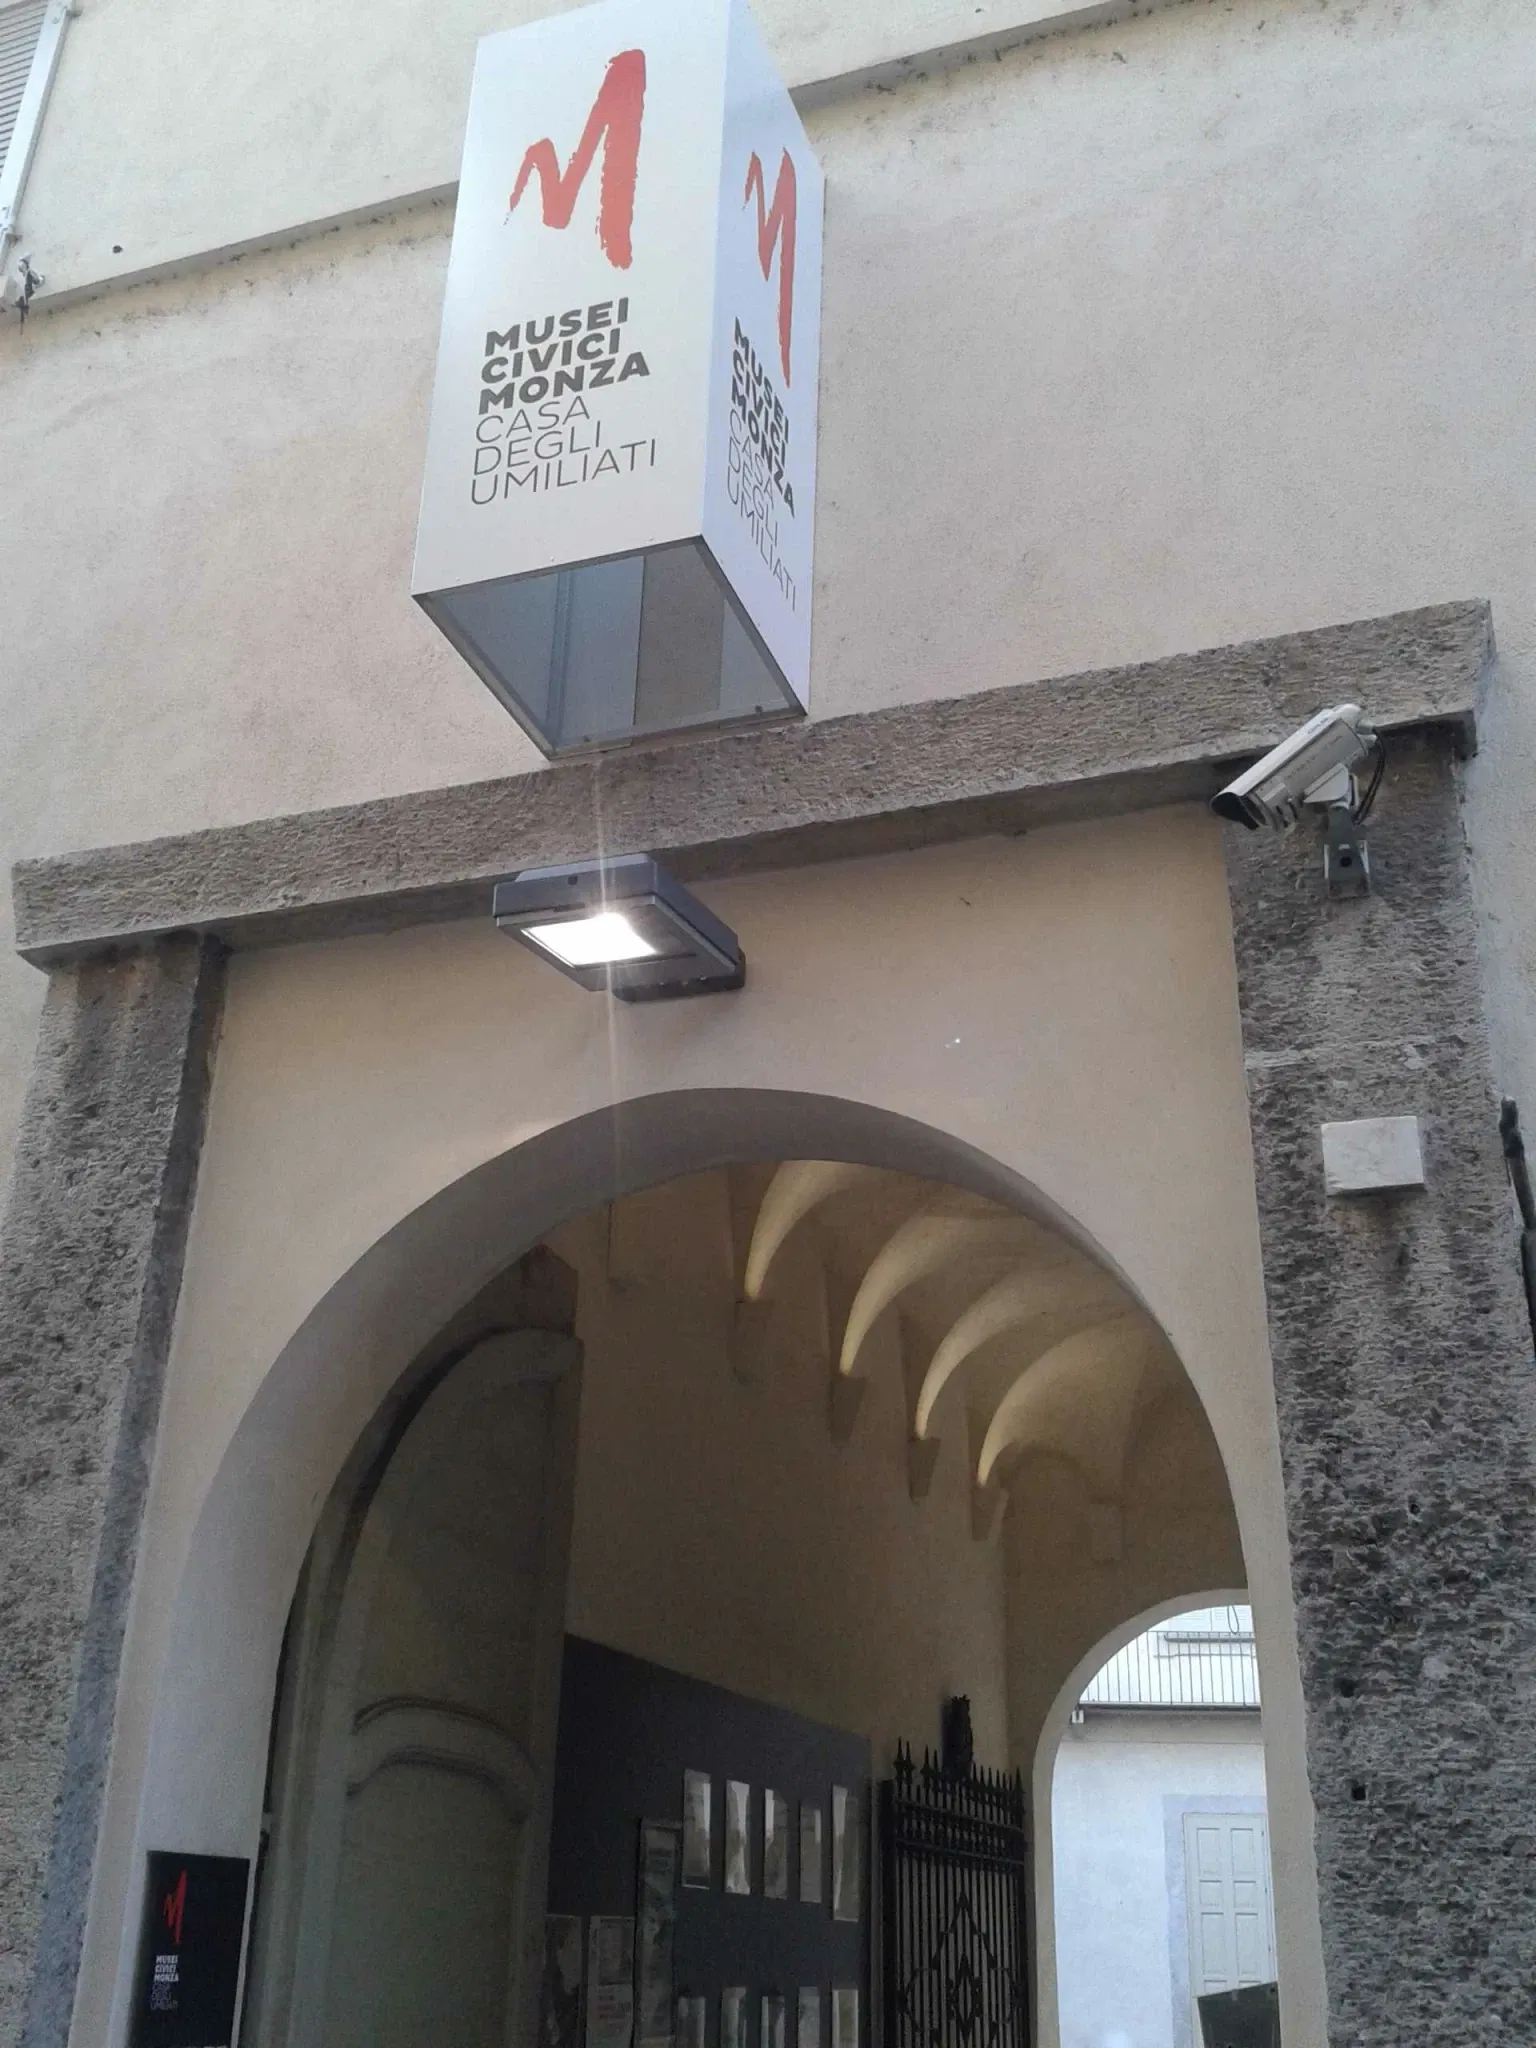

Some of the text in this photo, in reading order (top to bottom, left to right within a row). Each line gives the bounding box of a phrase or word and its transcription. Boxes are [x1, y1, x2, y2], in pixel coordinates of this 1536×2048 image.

[481, 327, 621, 384] CIVICI
[484, 296, 629, 357] MUSEI
[475, 395, 590, 444] CASA
[478, 351, 650, 416] MONZA
[732, 348, 787, 466] CIVICI
[735, 315, 789, 443] MUSEI
[471, 438, 656, 505] UMILIATI
[473, 420, 601, 476] DEGLI
[729, 408, 774, 510] CASA
[731, 375, 795, 518] MONZA
[728, 436, 778, 547] DEGLI
[727, 465, 797, 612] UMILIATI
